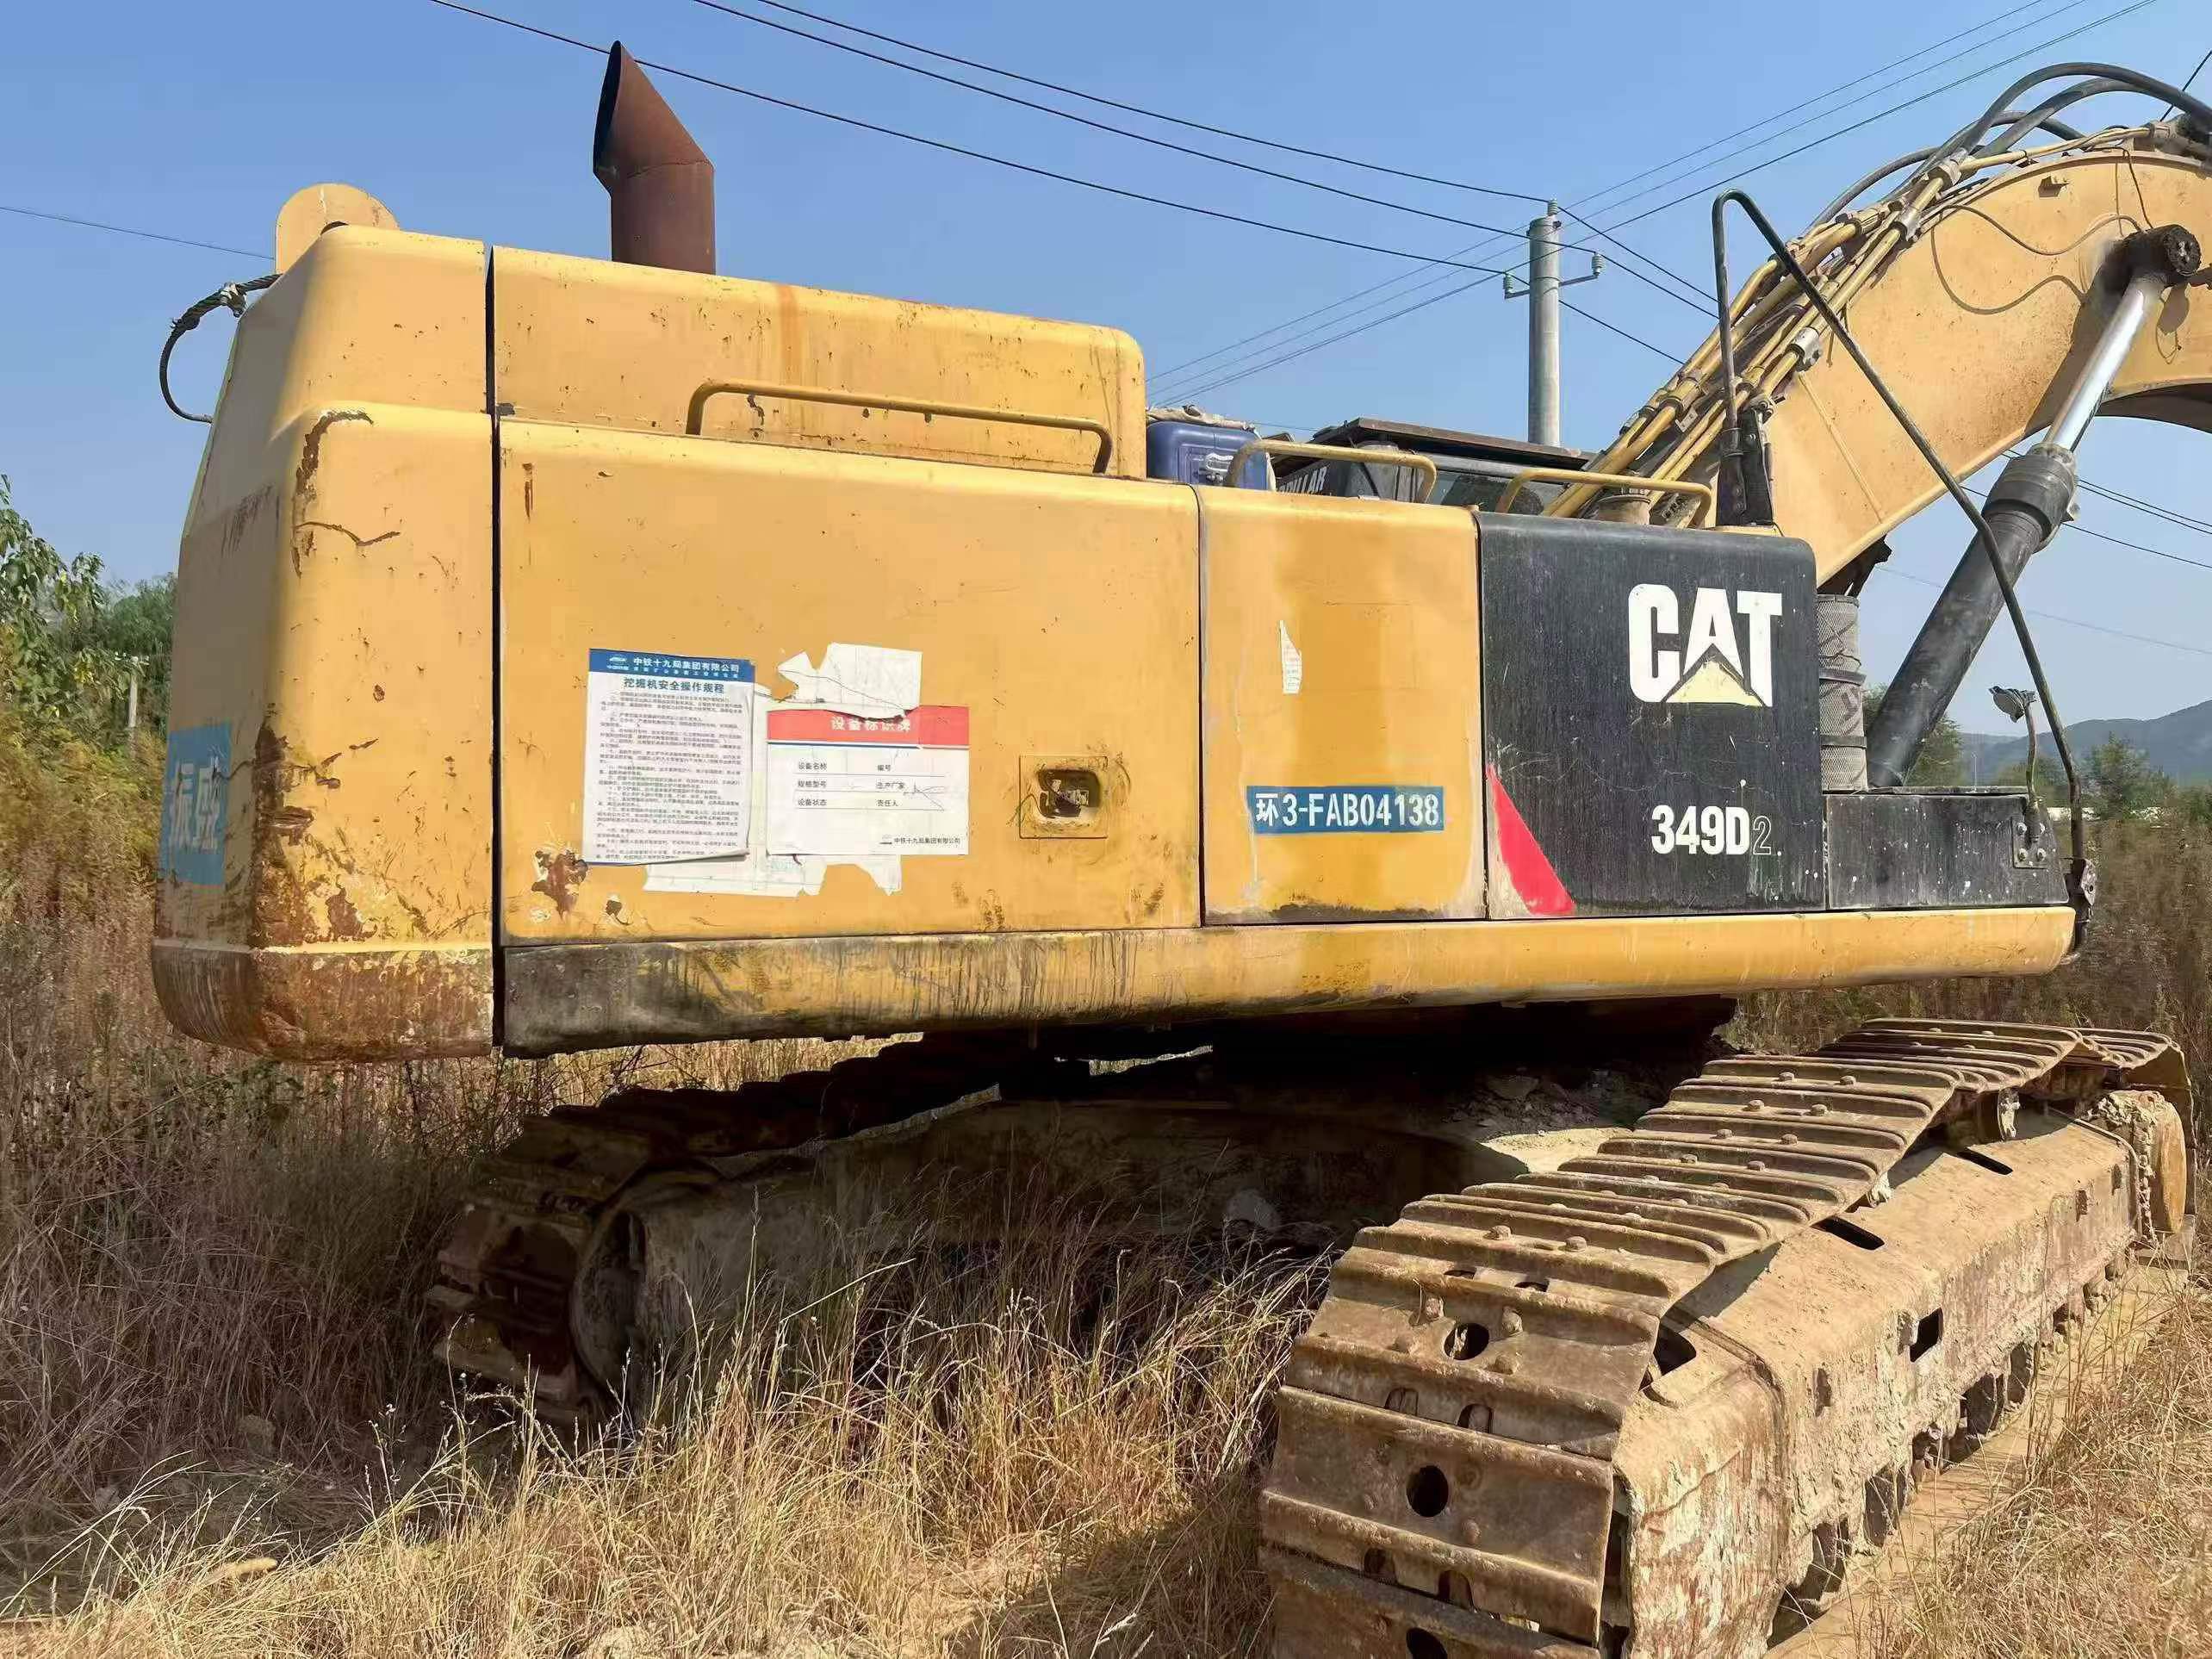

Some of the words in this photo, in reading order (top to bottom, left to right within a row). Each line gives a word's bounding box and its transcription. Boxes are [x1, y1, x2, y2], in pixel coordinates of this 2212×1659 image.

[1628, 583, 1783, 708] CAT
[633, 656, 740, 674] 中铁十九局集团有限公司
[623, 676, 724, 694] 挖掘机安全操作规程
[798, 761, 828, 770] 设备名称
[877, 763, 892, 772] 编号
[797, 780, 827, 788] 规格型号
[797, 798, 827, 806] 设备状态
[877, 798, 899, 807] 责任人
[1254, 792, 1440, 827] 环3-FAB04138
[1651, 805, 1772, 855] 349D2
